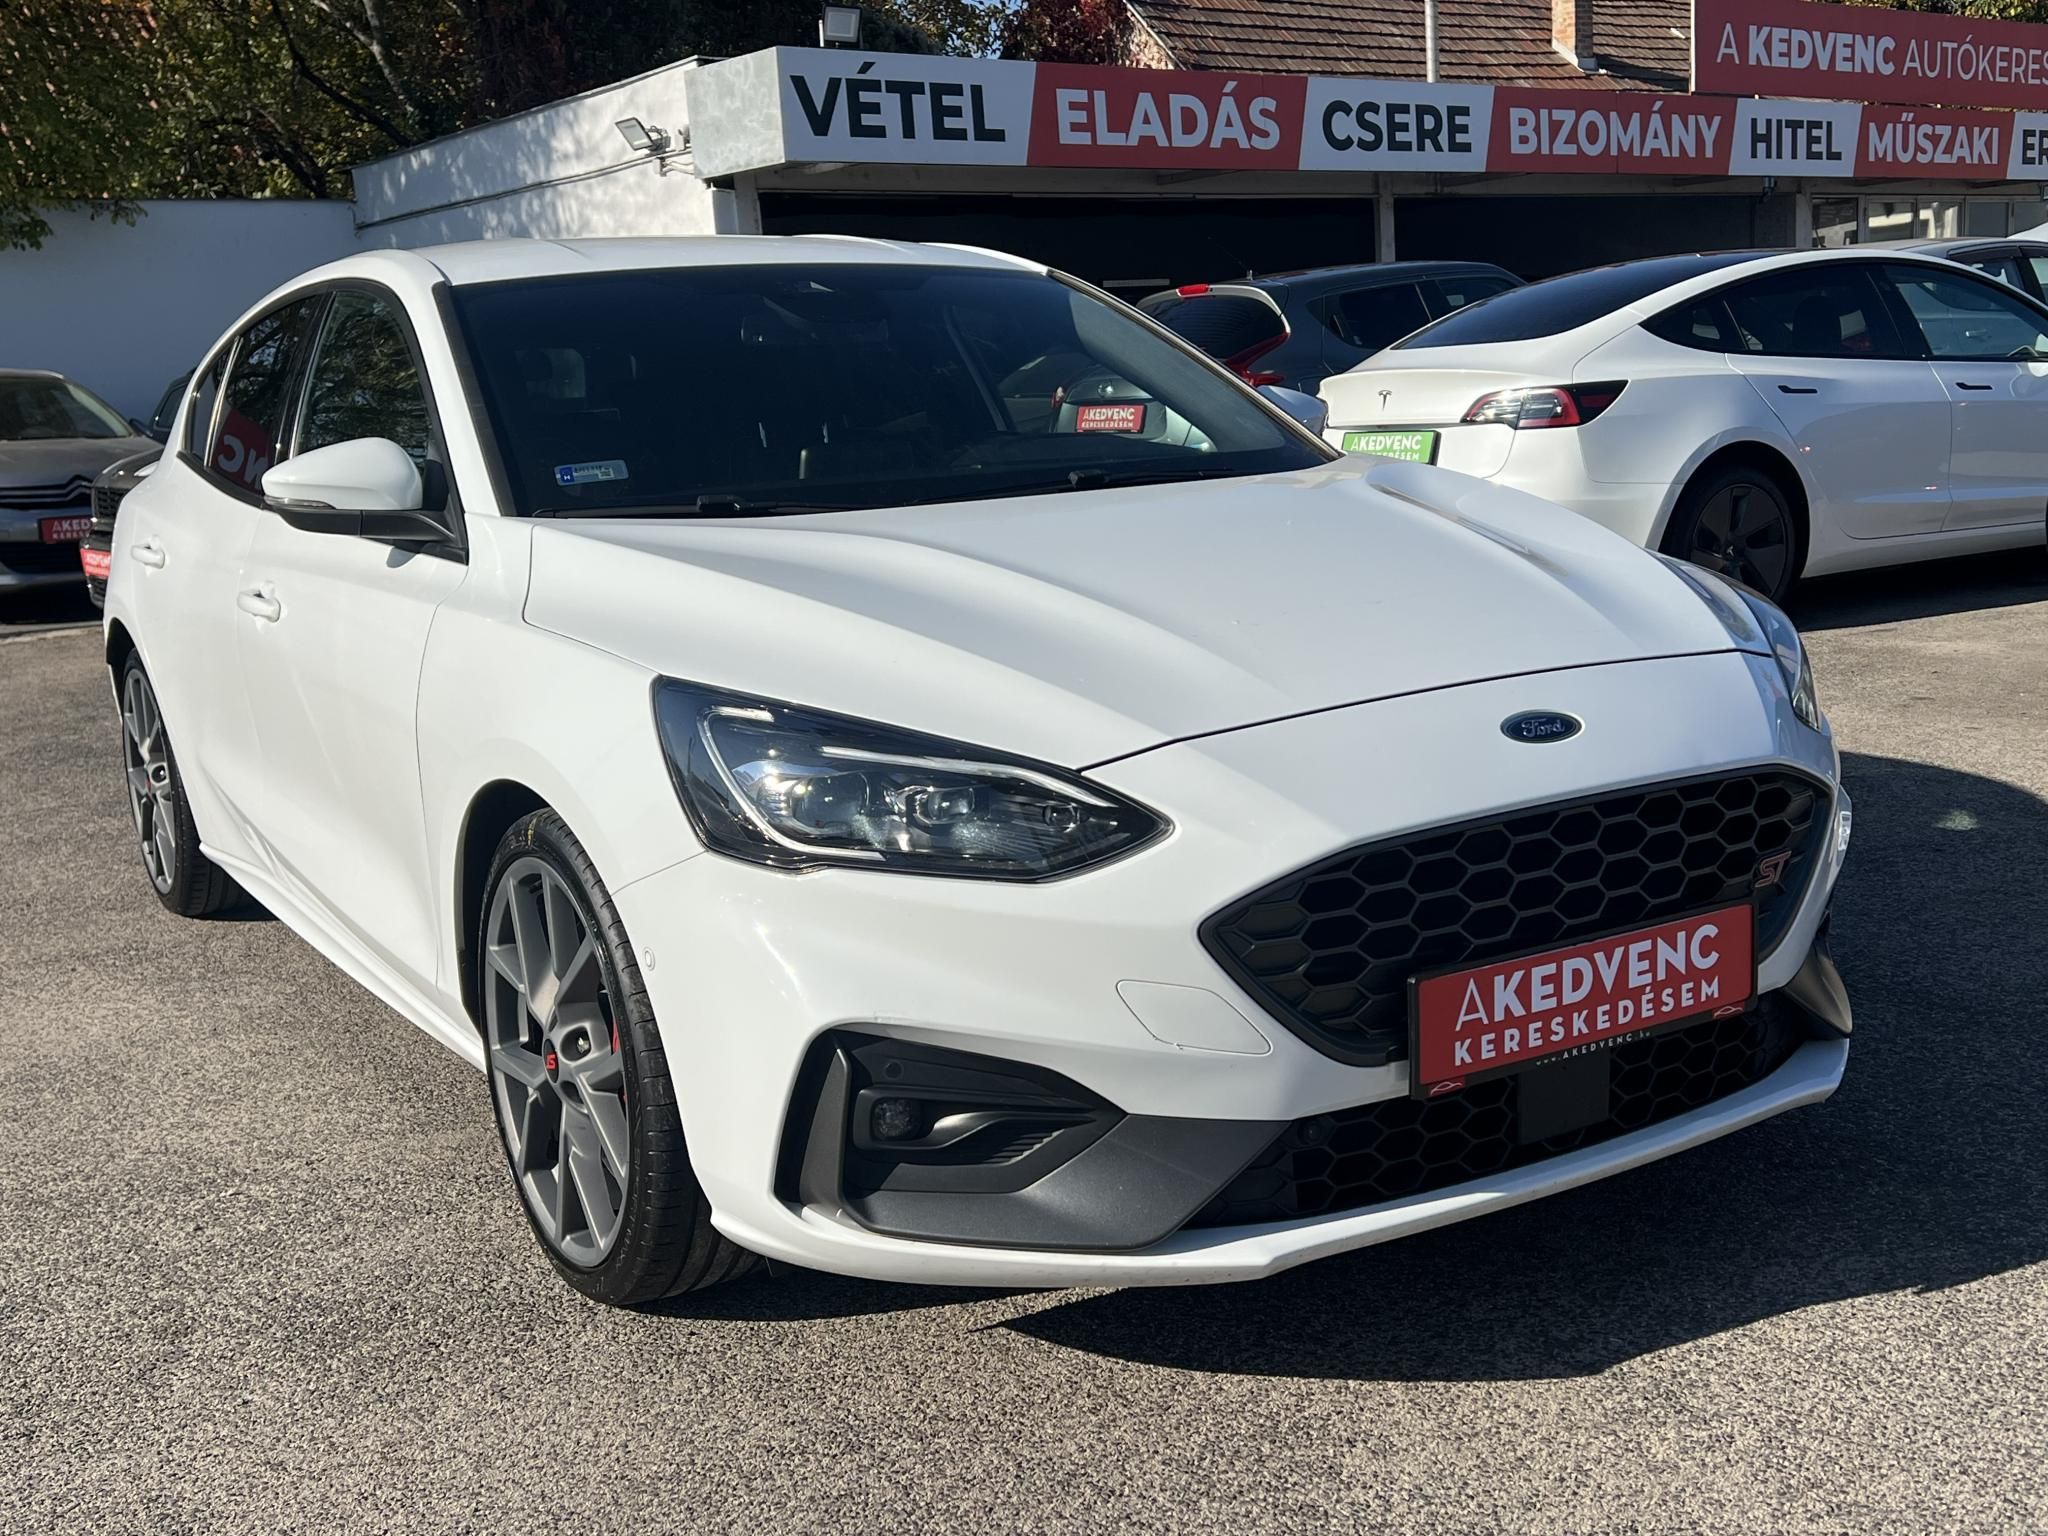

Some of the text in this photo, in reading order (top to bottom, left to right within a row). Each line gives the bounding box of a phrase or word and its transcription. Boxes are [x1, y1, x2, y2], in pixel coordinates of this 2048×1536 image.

[1716, 22, 1739, 64] A
[1748, 25, 1896, 75] KEDVENC
[789, 61, 1007, 143] VÉTEL
[1055, 80, 1282, 150] ELADÁS
[1321, 99, 1473, 153] CSERE
[1508, 100, 1723, 158] BIZOMÁNY
[1749, 117, 1844, 162] HITEL
[1867, 112, 2000, 166] MŰSZAKI
[1082, 407, 1135, 421] AKEDVENC
[1350, 434, 1423, 452] AKEDVENC
[1520, 717, 1566, 738] Ford
[1755, 849, 1792, 888] ST
[1455, 923, 1720, 1032] AKEDVENC
[1454, 975, 1720, 1067] KERESKEDÉSEM
